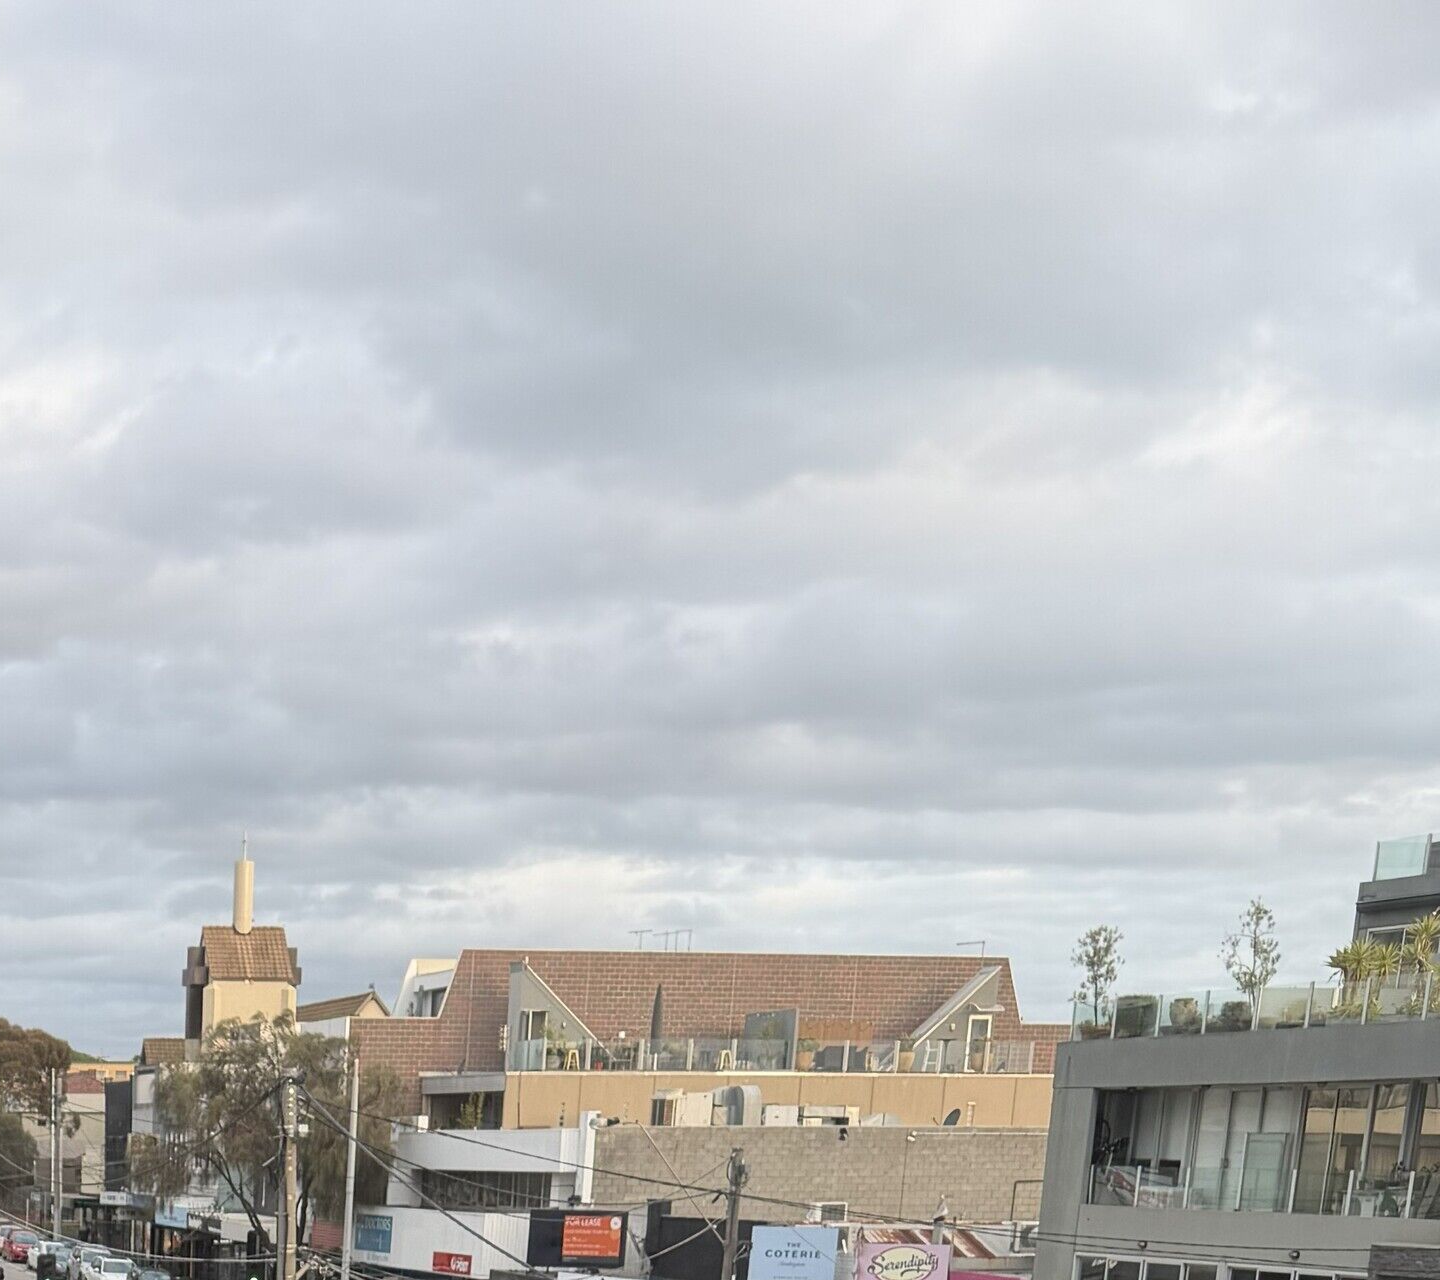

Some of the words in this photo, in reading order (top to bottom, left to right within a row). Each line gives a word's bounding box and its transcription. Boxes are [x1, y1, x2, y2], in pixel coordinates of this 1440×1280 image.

[581, 1216, 601, 1227] LEASE
[765, 1249, 821, 1260] COTERIE
[867, 1252, 939, 1276] Serendipity
